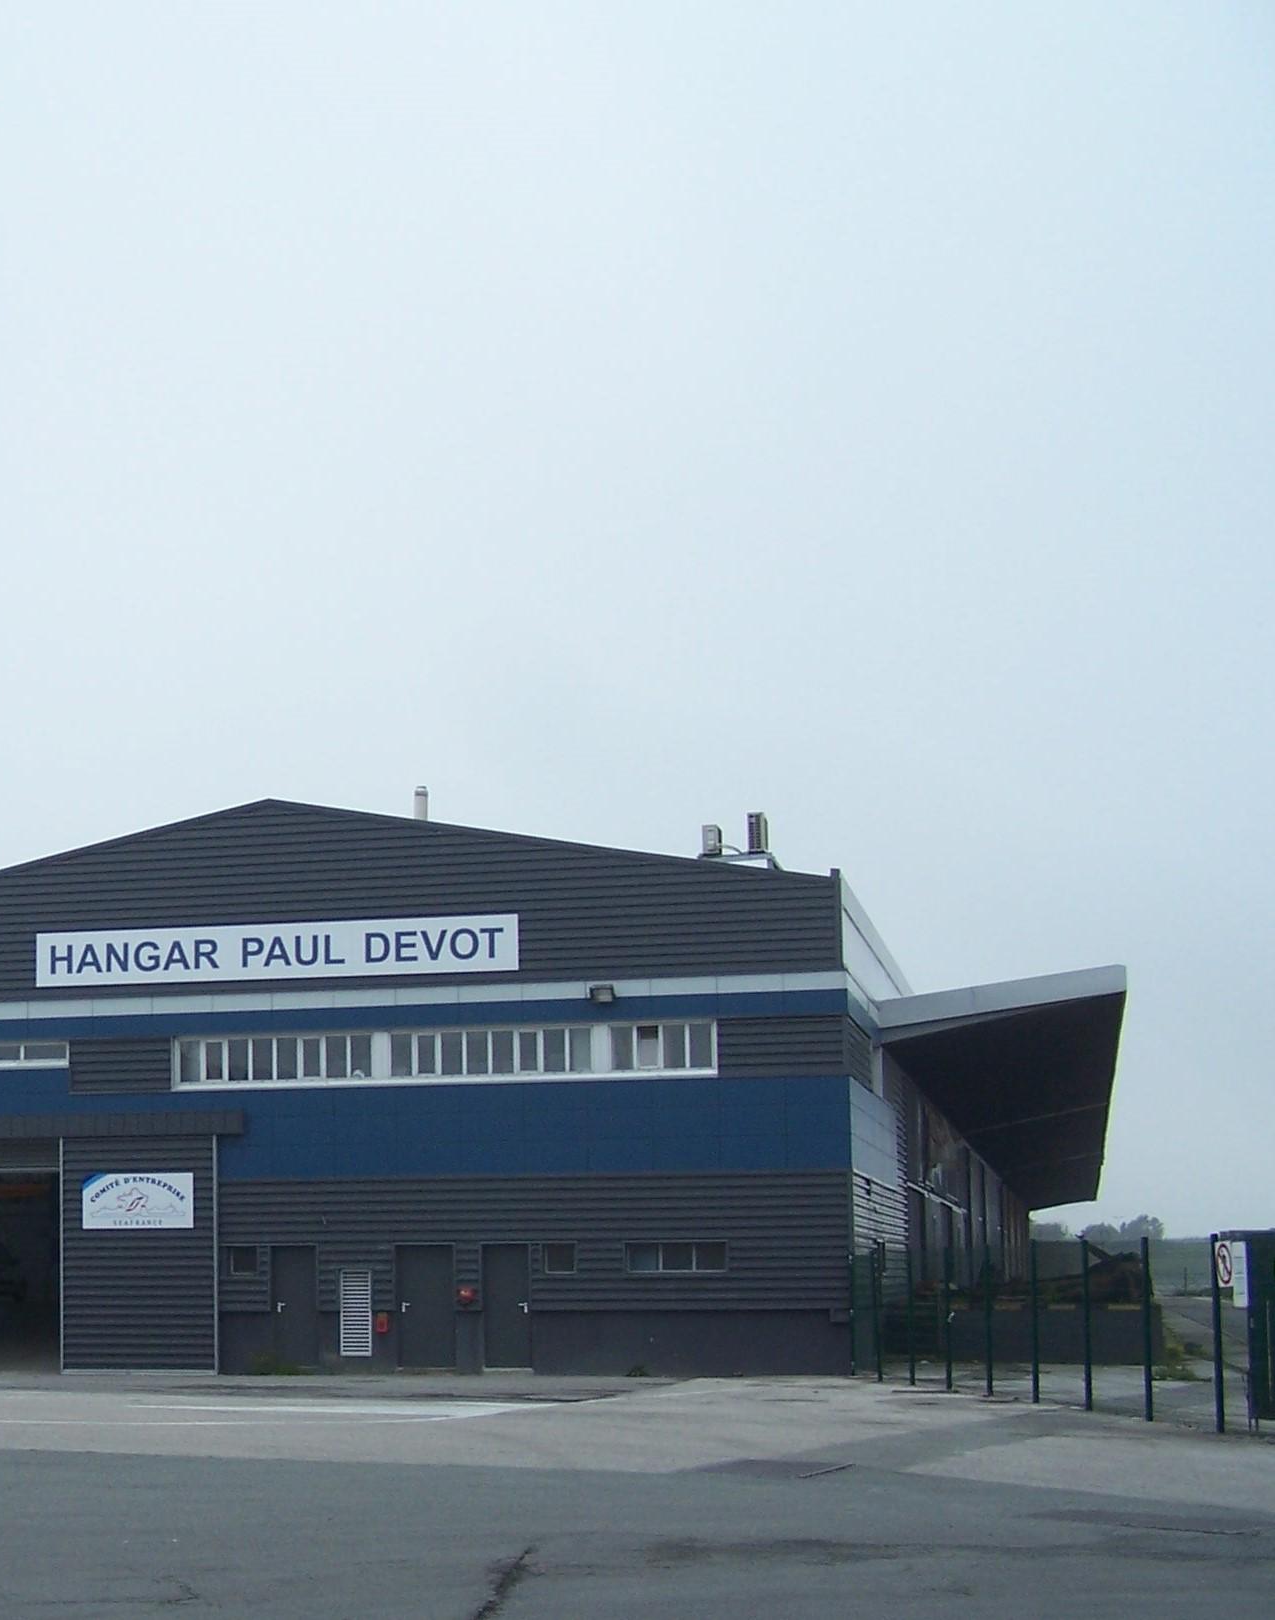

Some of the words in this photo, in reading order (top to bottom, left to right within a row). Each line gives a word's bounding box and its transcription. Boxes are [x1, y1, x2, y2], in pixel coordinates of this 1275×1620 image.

[50, 939, 220, 975] HANGAR
[241, 934, 345, 968] PAUL
[365, 927, 504, 963] DEVOT
[90, 1179, 120, 1203] COMITÉ
[124, 1176, 186, 1202] D'ENTREPRISE
